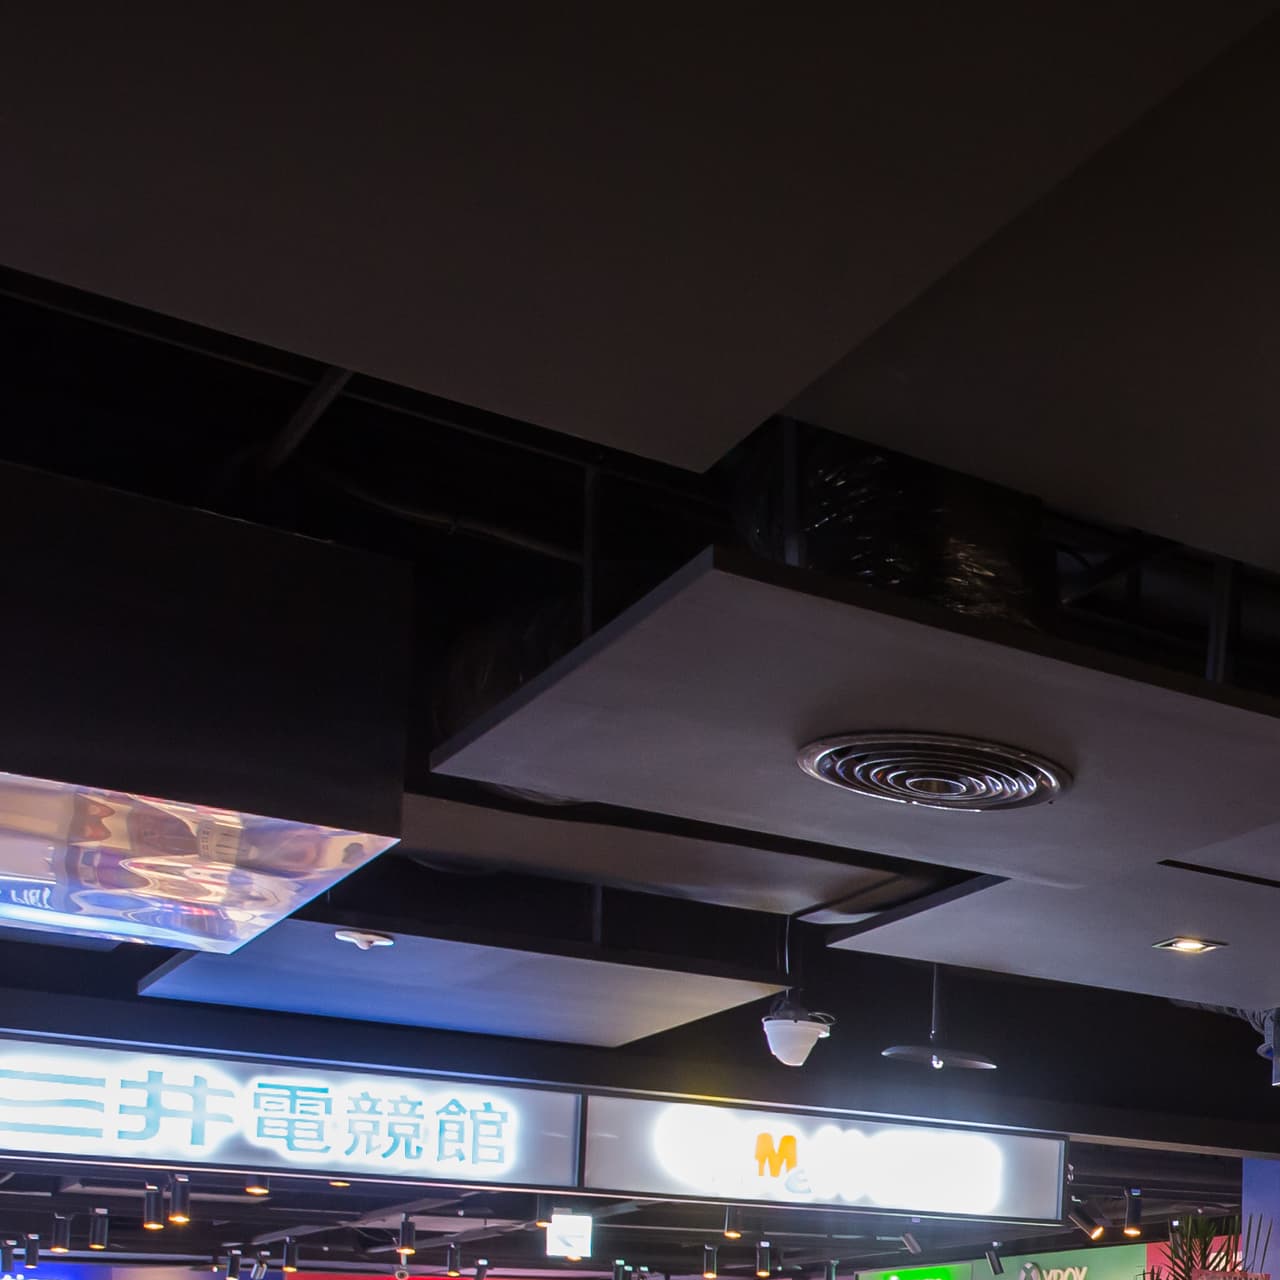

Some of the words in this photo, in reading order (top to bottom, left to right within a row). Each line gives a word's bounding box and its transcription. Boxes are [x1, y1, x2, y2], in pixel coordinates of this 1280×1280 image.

[0, 1069, 509, 1165] 三井電競館
